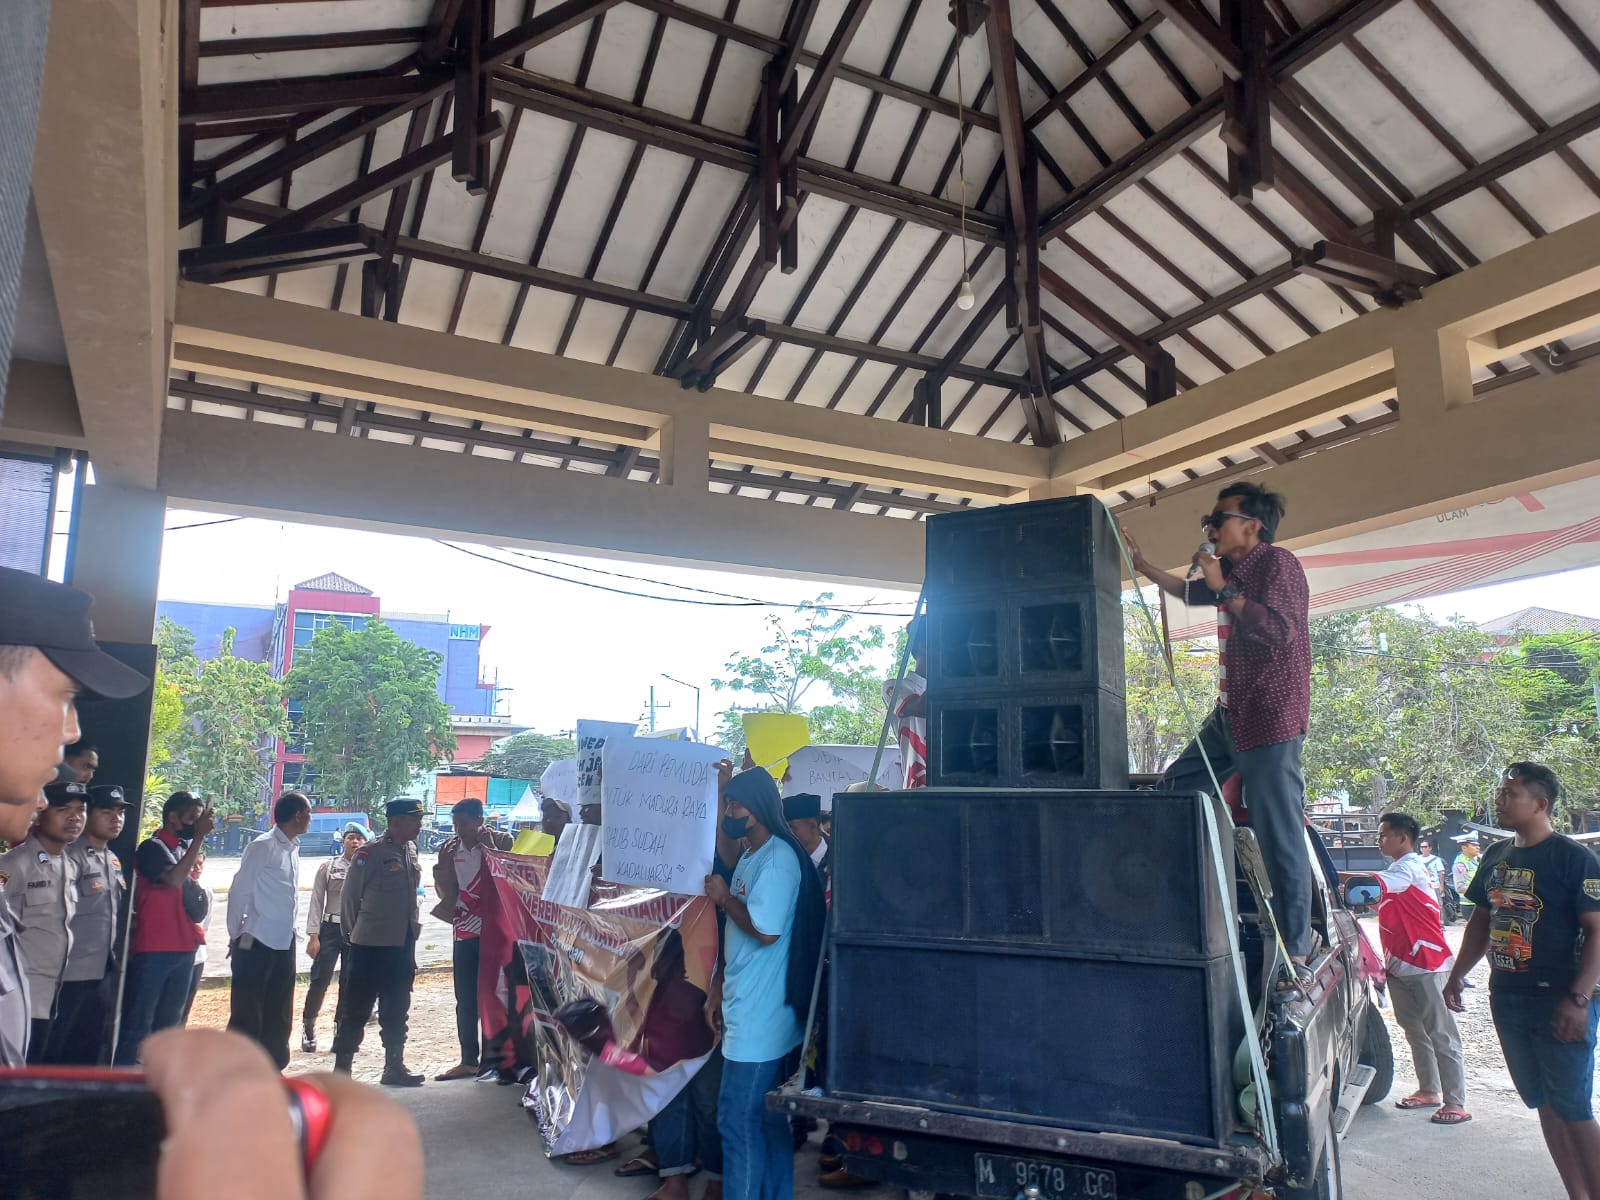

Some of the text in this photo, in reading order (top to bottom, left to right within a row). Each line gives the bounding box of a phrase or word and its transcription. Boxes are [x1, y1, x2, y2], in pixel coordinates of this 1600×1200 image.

[450, 626, 479, 639] NHM
[659, 753, 708, 786] PEMUDA
[631, 828, 667, 855] SUDAH
[979, 1158, 1110, 1198] M 9678 GC
